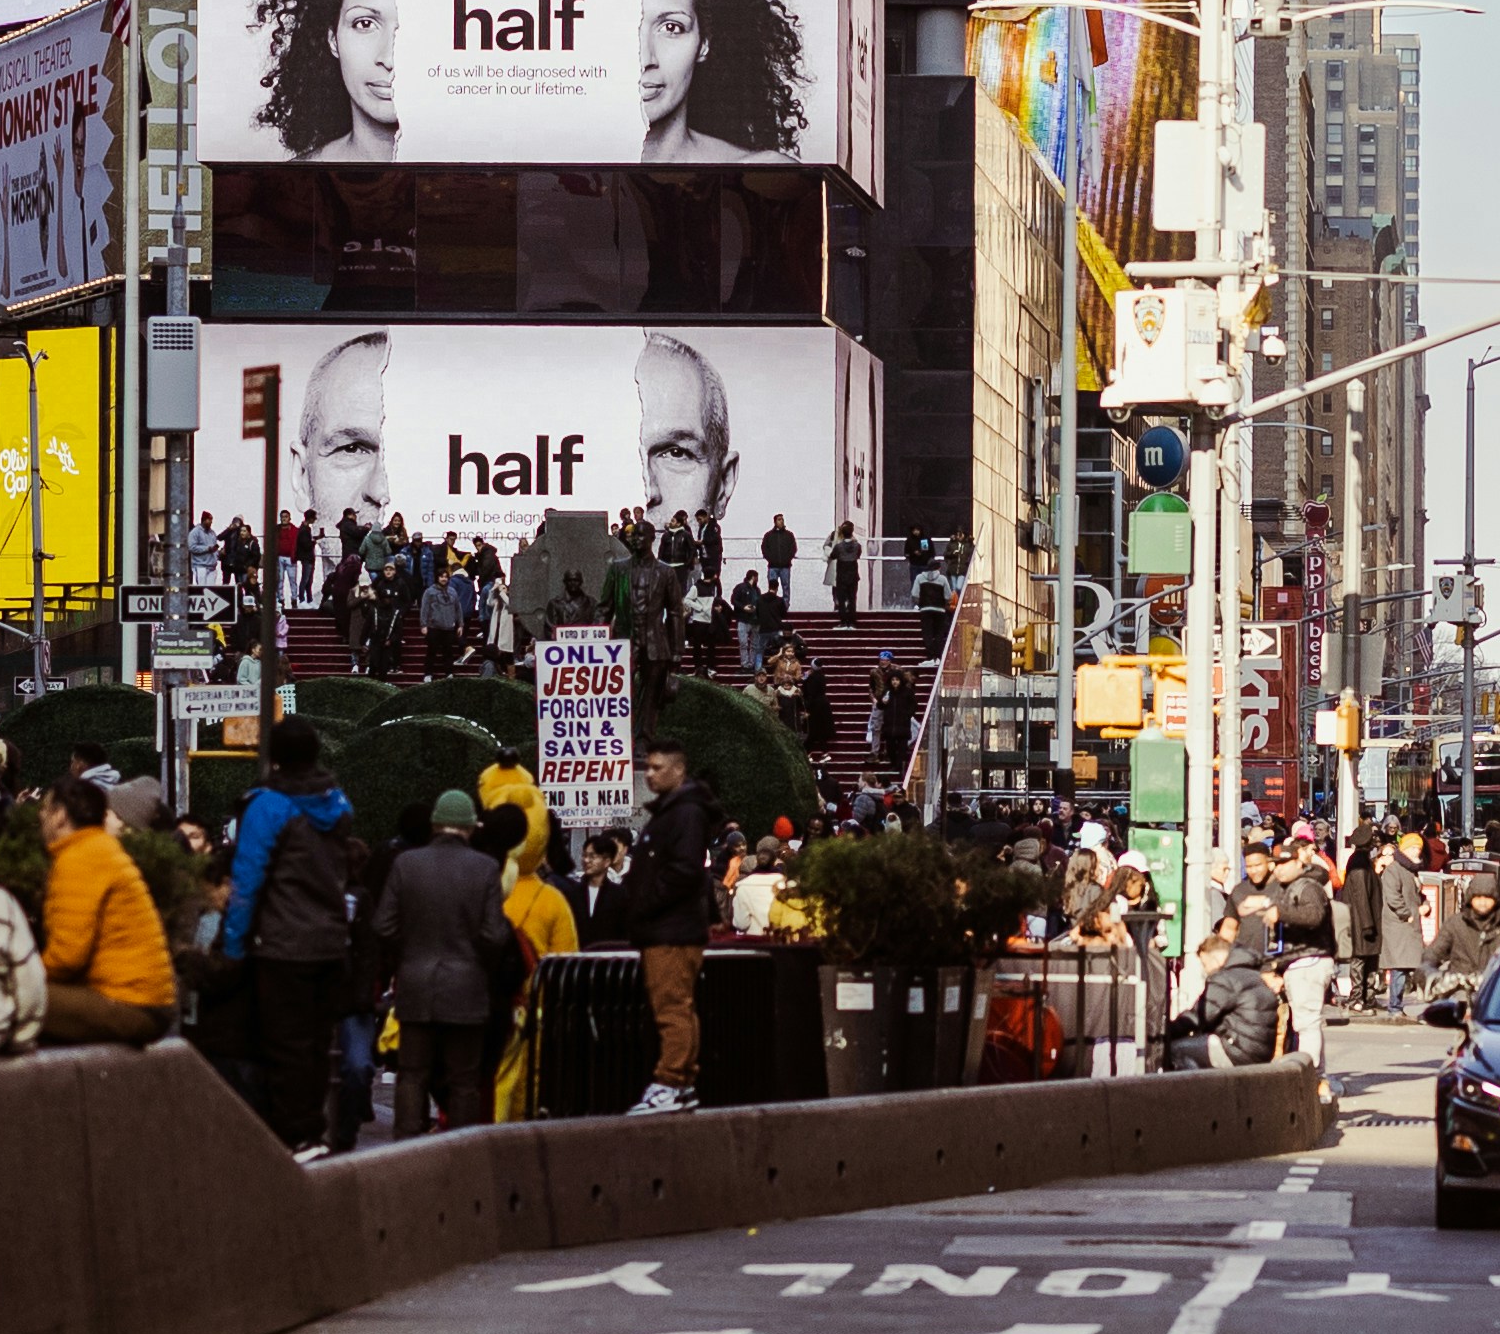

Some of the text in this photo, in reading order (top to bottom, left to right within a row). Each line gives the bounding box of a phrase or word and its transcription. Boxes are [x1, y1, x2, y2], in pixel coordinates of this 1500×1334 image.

[34, 37, 73, 80] THEATER
[427, 65, 607, 81] of us will be diagnosed with
[53, 63, 101, 129] STYLE
[447, 82, 587, 95] cancer in our lifetime.
[449, 434, 584, 496] half
[422, 510, 436, 523] of
[440, 513, 455, 523] us
[459, 510, 480, 523] will
[483, 510, 500, 523] be
[544, 644, 623, 665] ONLY
[543, 665, 625, 696] JESUS
[184, 690, 222, 702] PEDESTRIAN
[242, 689, 258, 699] ZONE
[539, 697, 630, 720] FORGIVES
[553, 720, 615, 738] SIN &
[544, 739, 624, 757] SAVES
[541, 759, 630, 783] REPENT
[576, 790, 589, 807] IS
[598, 789, 630, 806] NEAR
[514, 1260, 1173, 1300] ONLY
